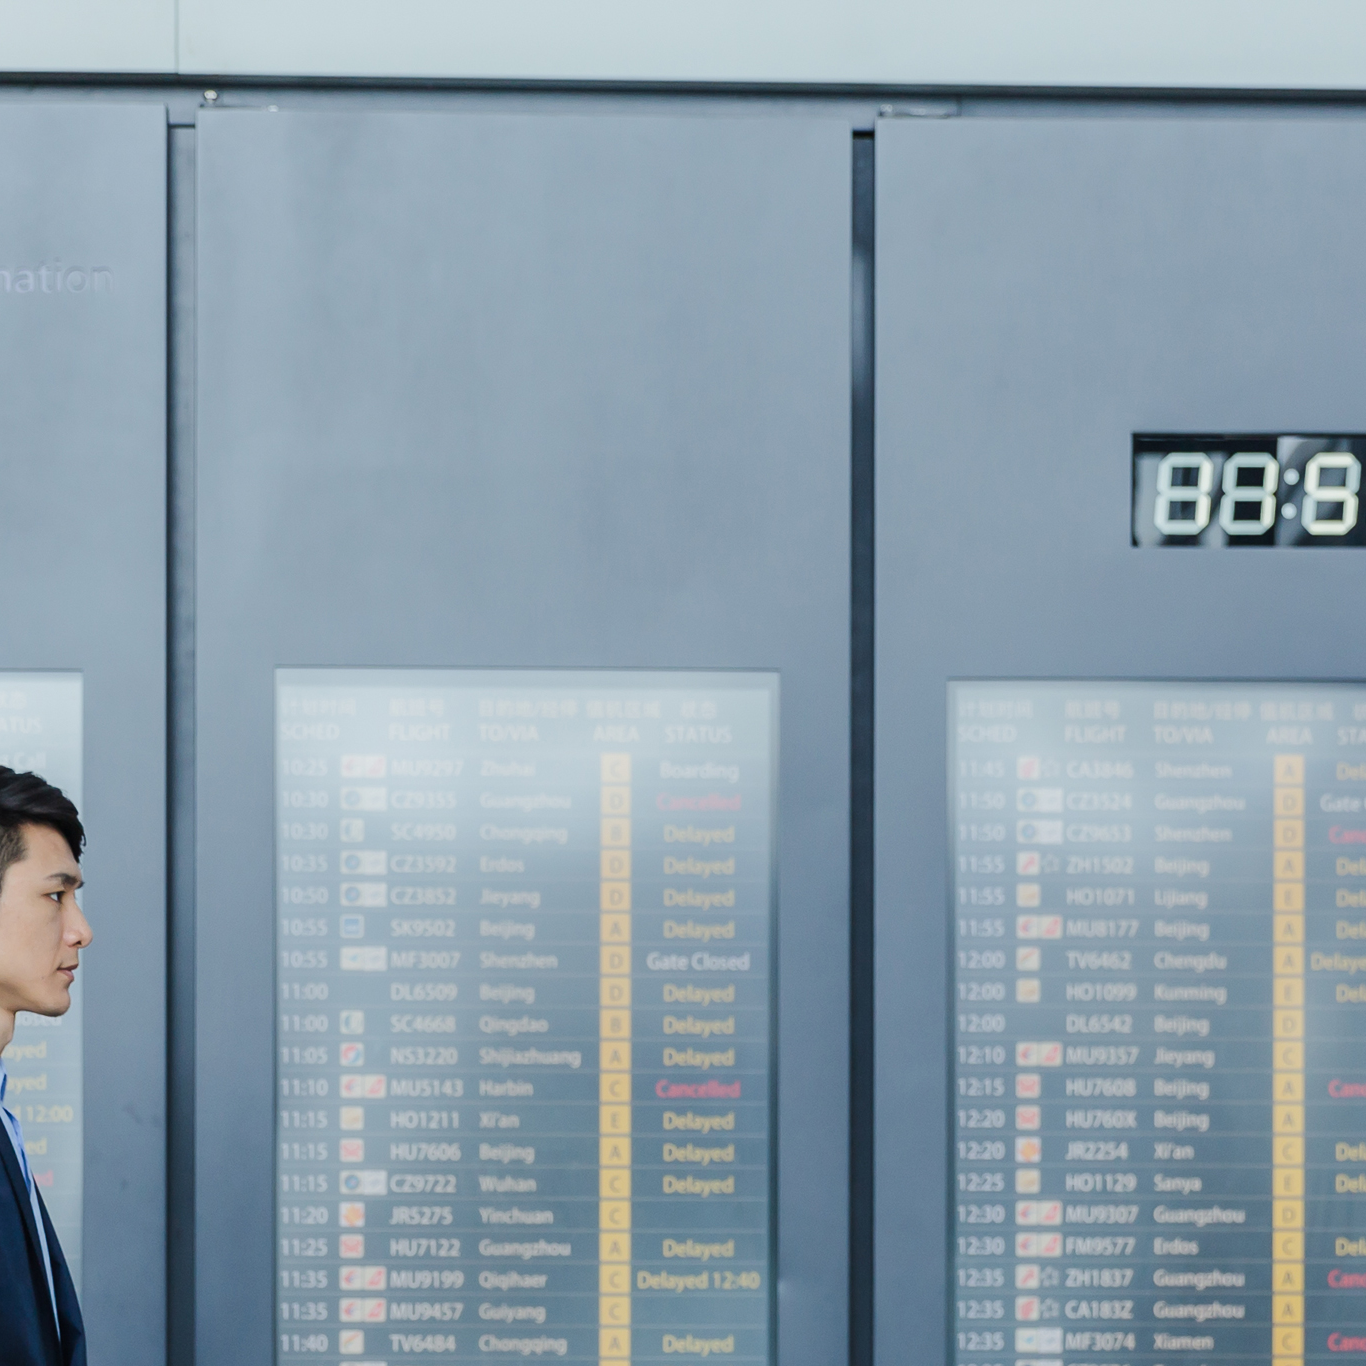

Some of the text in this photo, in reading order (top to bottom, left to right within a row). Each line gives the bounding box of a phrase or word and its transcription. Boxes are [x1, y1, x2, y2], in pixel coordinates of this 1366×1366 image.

[1065, 726, 1126, 744] FLIGHT
[1267, 728, 1313, 745] AREA
[281, 949, 327, 968] 10:55
[647, 952, 688, 970] Gate
[691, 952, 750, 970] Closed
[958, 950, 1005, 969] 12:00
[281, 1014, 328, 1032] 11:00
[663, 1016, 735, 1037] Delayed
[281, 1046, 327, 1064] 11:05
[663, 1047, 735, 1070] Delayed
[27, 1105, 73, 1123] 12:00
[281, 1142, 327, 1160] 11:15
[663, 1143, 735, 1166] Delayed
[958, 1141, 1005, 1160] 12:20
[281, 1174, 327, 1192] 11:15
[663, 1175, 734, 1197] Delayed
[958, 1173, 1004, 1192] 12:25
[281, 1206, 328, 1224] 11:20
[280, 1238, 328, 1256] 11:25
[663, 1239, 734, 1261] Delayed
[958, 1236, 1005, 1255] 12:30
[280, 1270, 327, 1288] 11:35
[637, 1271, 708, 1293] Delayed
[714, 1271, 760, 1289] 12:40
[958, 1268, 1004, 1287] 12:35
[281, 1334, 328, 1352] 11:40
[663, 1335, 734, 1357] Delayed
[958, 1332, 1004, 1350] 12:35
